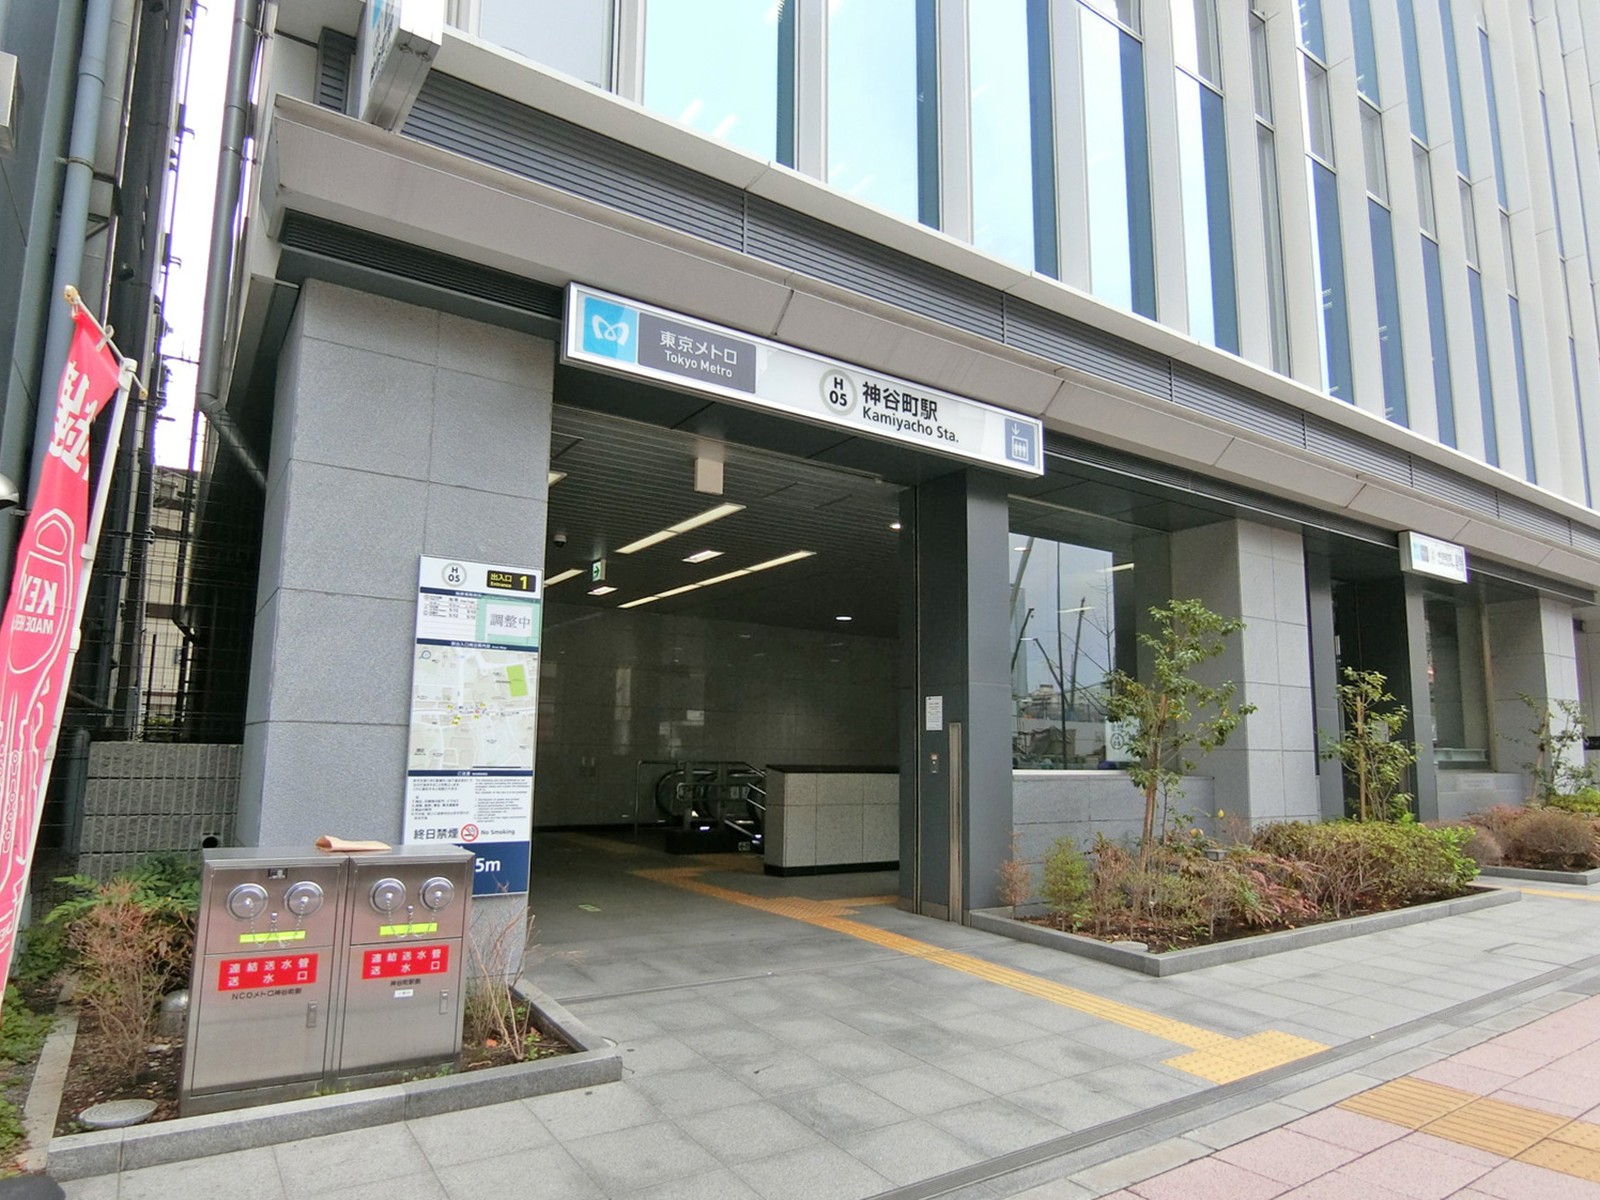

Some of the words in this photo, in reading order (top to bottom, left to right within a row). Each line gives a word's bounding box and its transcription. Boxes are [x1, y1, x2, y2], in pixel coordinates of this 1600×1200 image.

[660, 331, 738, 365] 東京メトロ
[664, 350, 698, 369] Tokyo
[700, 360, 733, 378] Metro
[833, 377, 844, 391] H
[829, 390, 848, 407] 05
[862, 381, 938, 422] 神谷町駅
[863, 406, 933, 436] Kamiyacho
[937, 425, 960, 443] Sta.
[490, 572, 513, 582] 出入口
[519, 575, 528, 590] 1
[490, 613, 531, 629] 調整中
[413, 828, 459, 840] 終日禁煙
